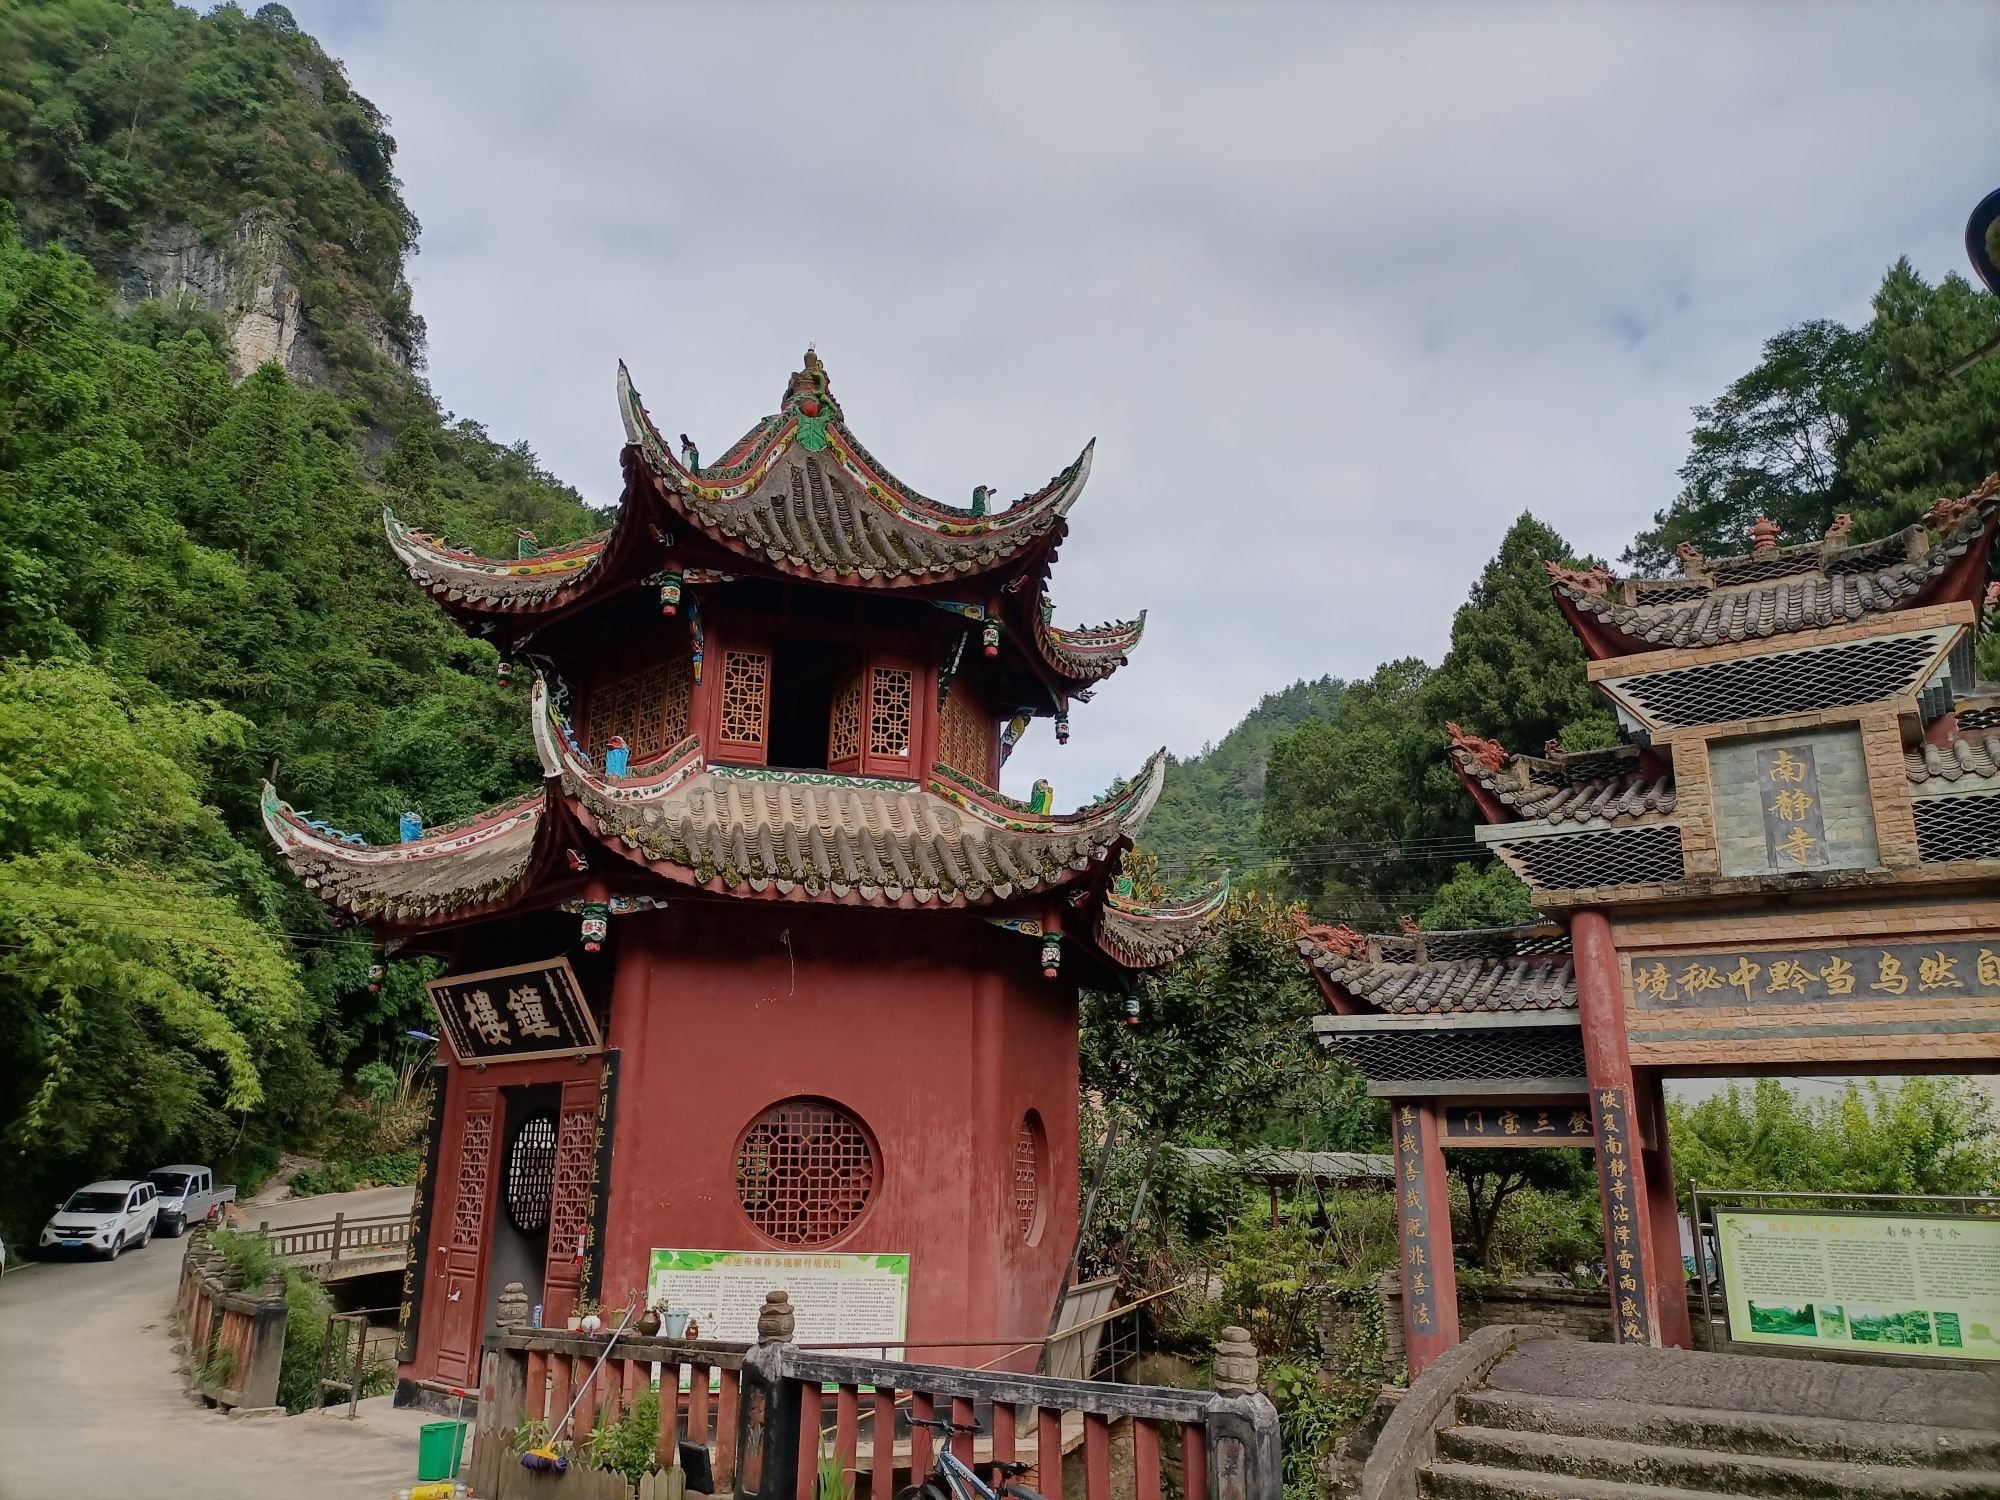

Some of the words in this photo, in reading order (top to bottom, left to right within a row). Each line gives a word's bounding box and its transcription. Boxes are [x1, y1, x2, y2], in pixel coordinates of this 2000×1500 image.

[1768, 750, 1817, 865] 南静寺
[1464, 1110, 1592, 1134] 登三宝门
